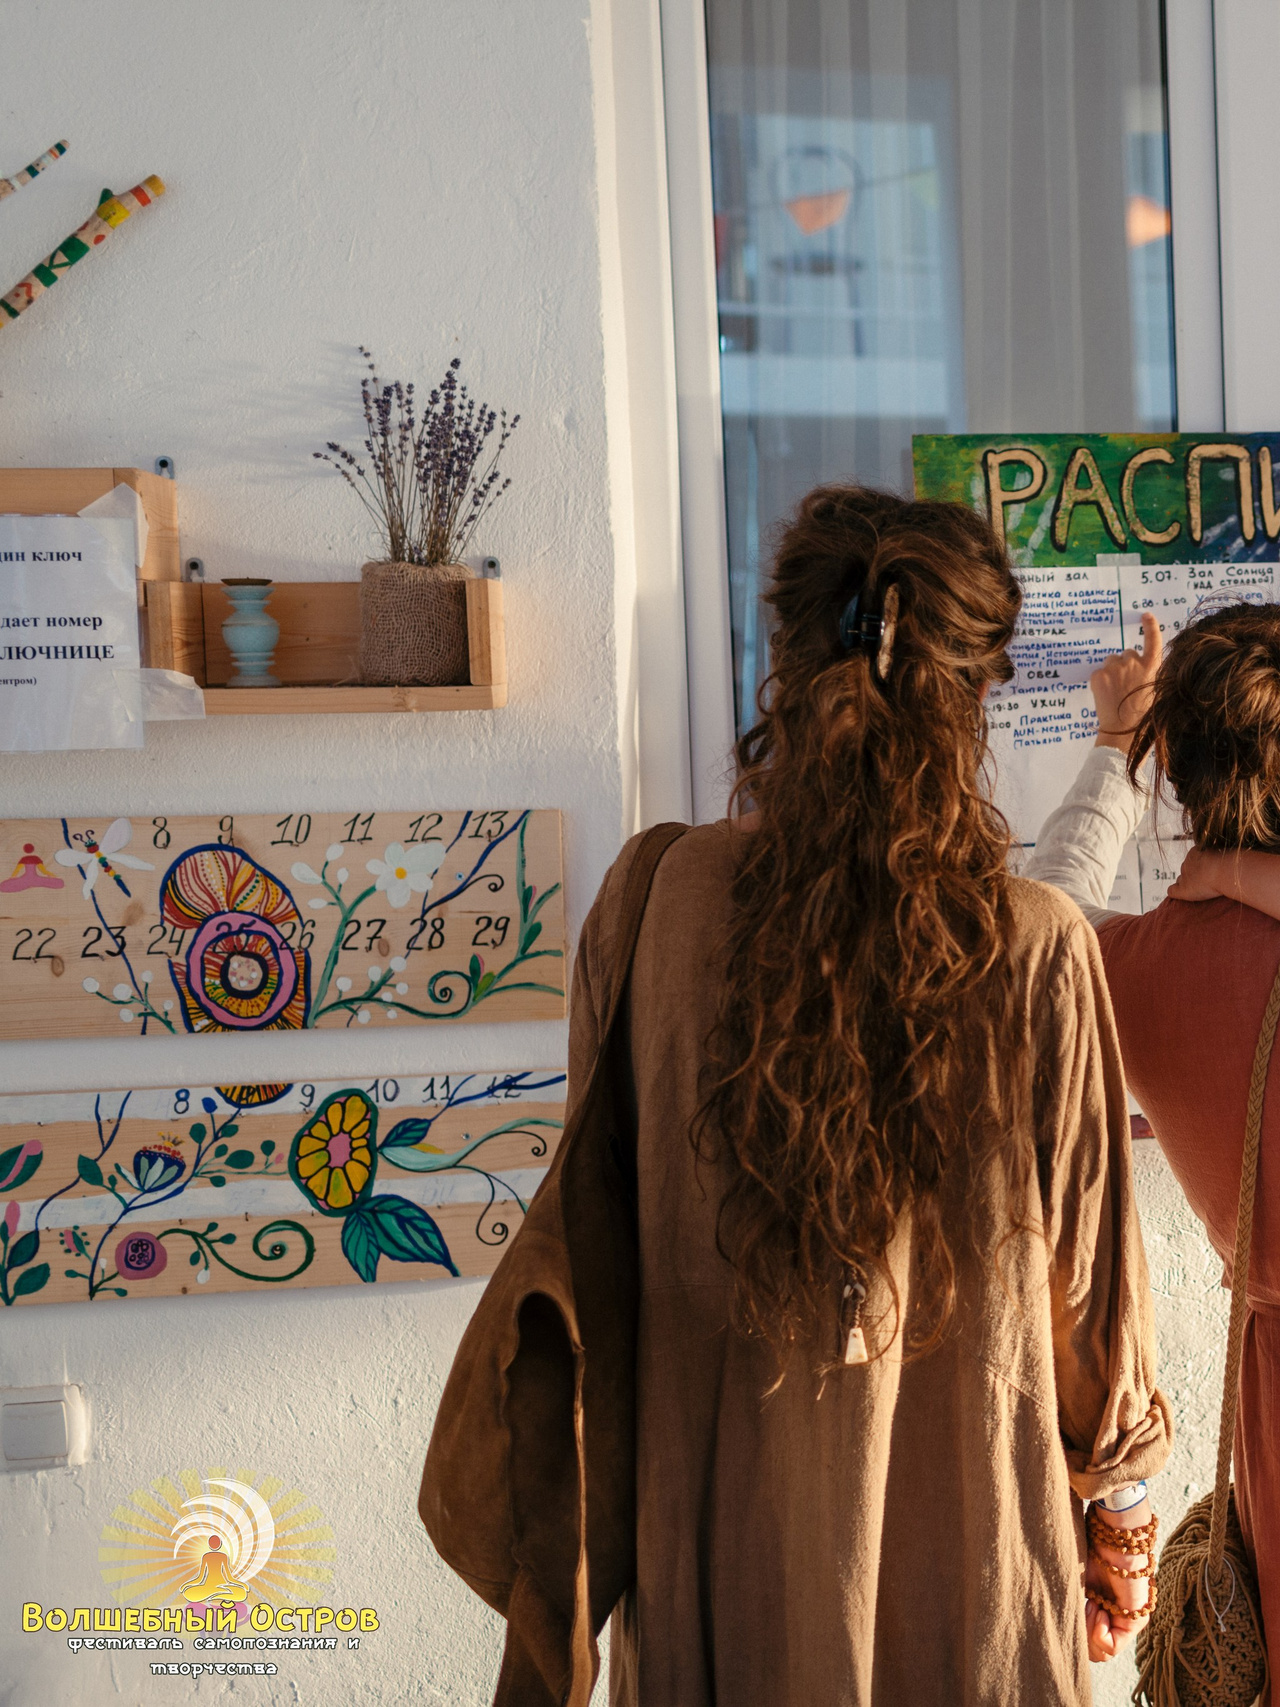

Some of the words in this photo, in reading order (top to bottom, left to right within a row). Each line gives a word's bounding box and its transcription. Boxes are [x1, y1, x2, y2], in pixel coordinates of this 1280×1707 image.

[0, 552, 25, 563] ин
[32, 552, 82, 562] ключ
[1188, 566, 1214, 578] Зал
[1226, 566, 1274, 577] Солнца
[46, 616, 103, 631] номер
[152, 816, 171, 849] 8
[217, 815, 235, 847] 9
[270, 813, 312, 846] 10
[340, 812, 375, 843] 11
[404, 813, 443, 843] 12
[468, 811, 508, 839] 13
[1152, 868, 1176, 881] Зал
[12, 928, 57, 961] 22
[81, 926, 127, 957] 23
[147, 924, 186, 956] 24
[279, 919, 316, 951] 26
[341, 919, 386, 950] 27
[406, 917, 445, 950] 28
[471, 916, 510, 947] 29
[300, 1083, 316, 1107] 9
[366, 1078, 399, 1102] 10
[423, 1075, 452, 1102] 11
